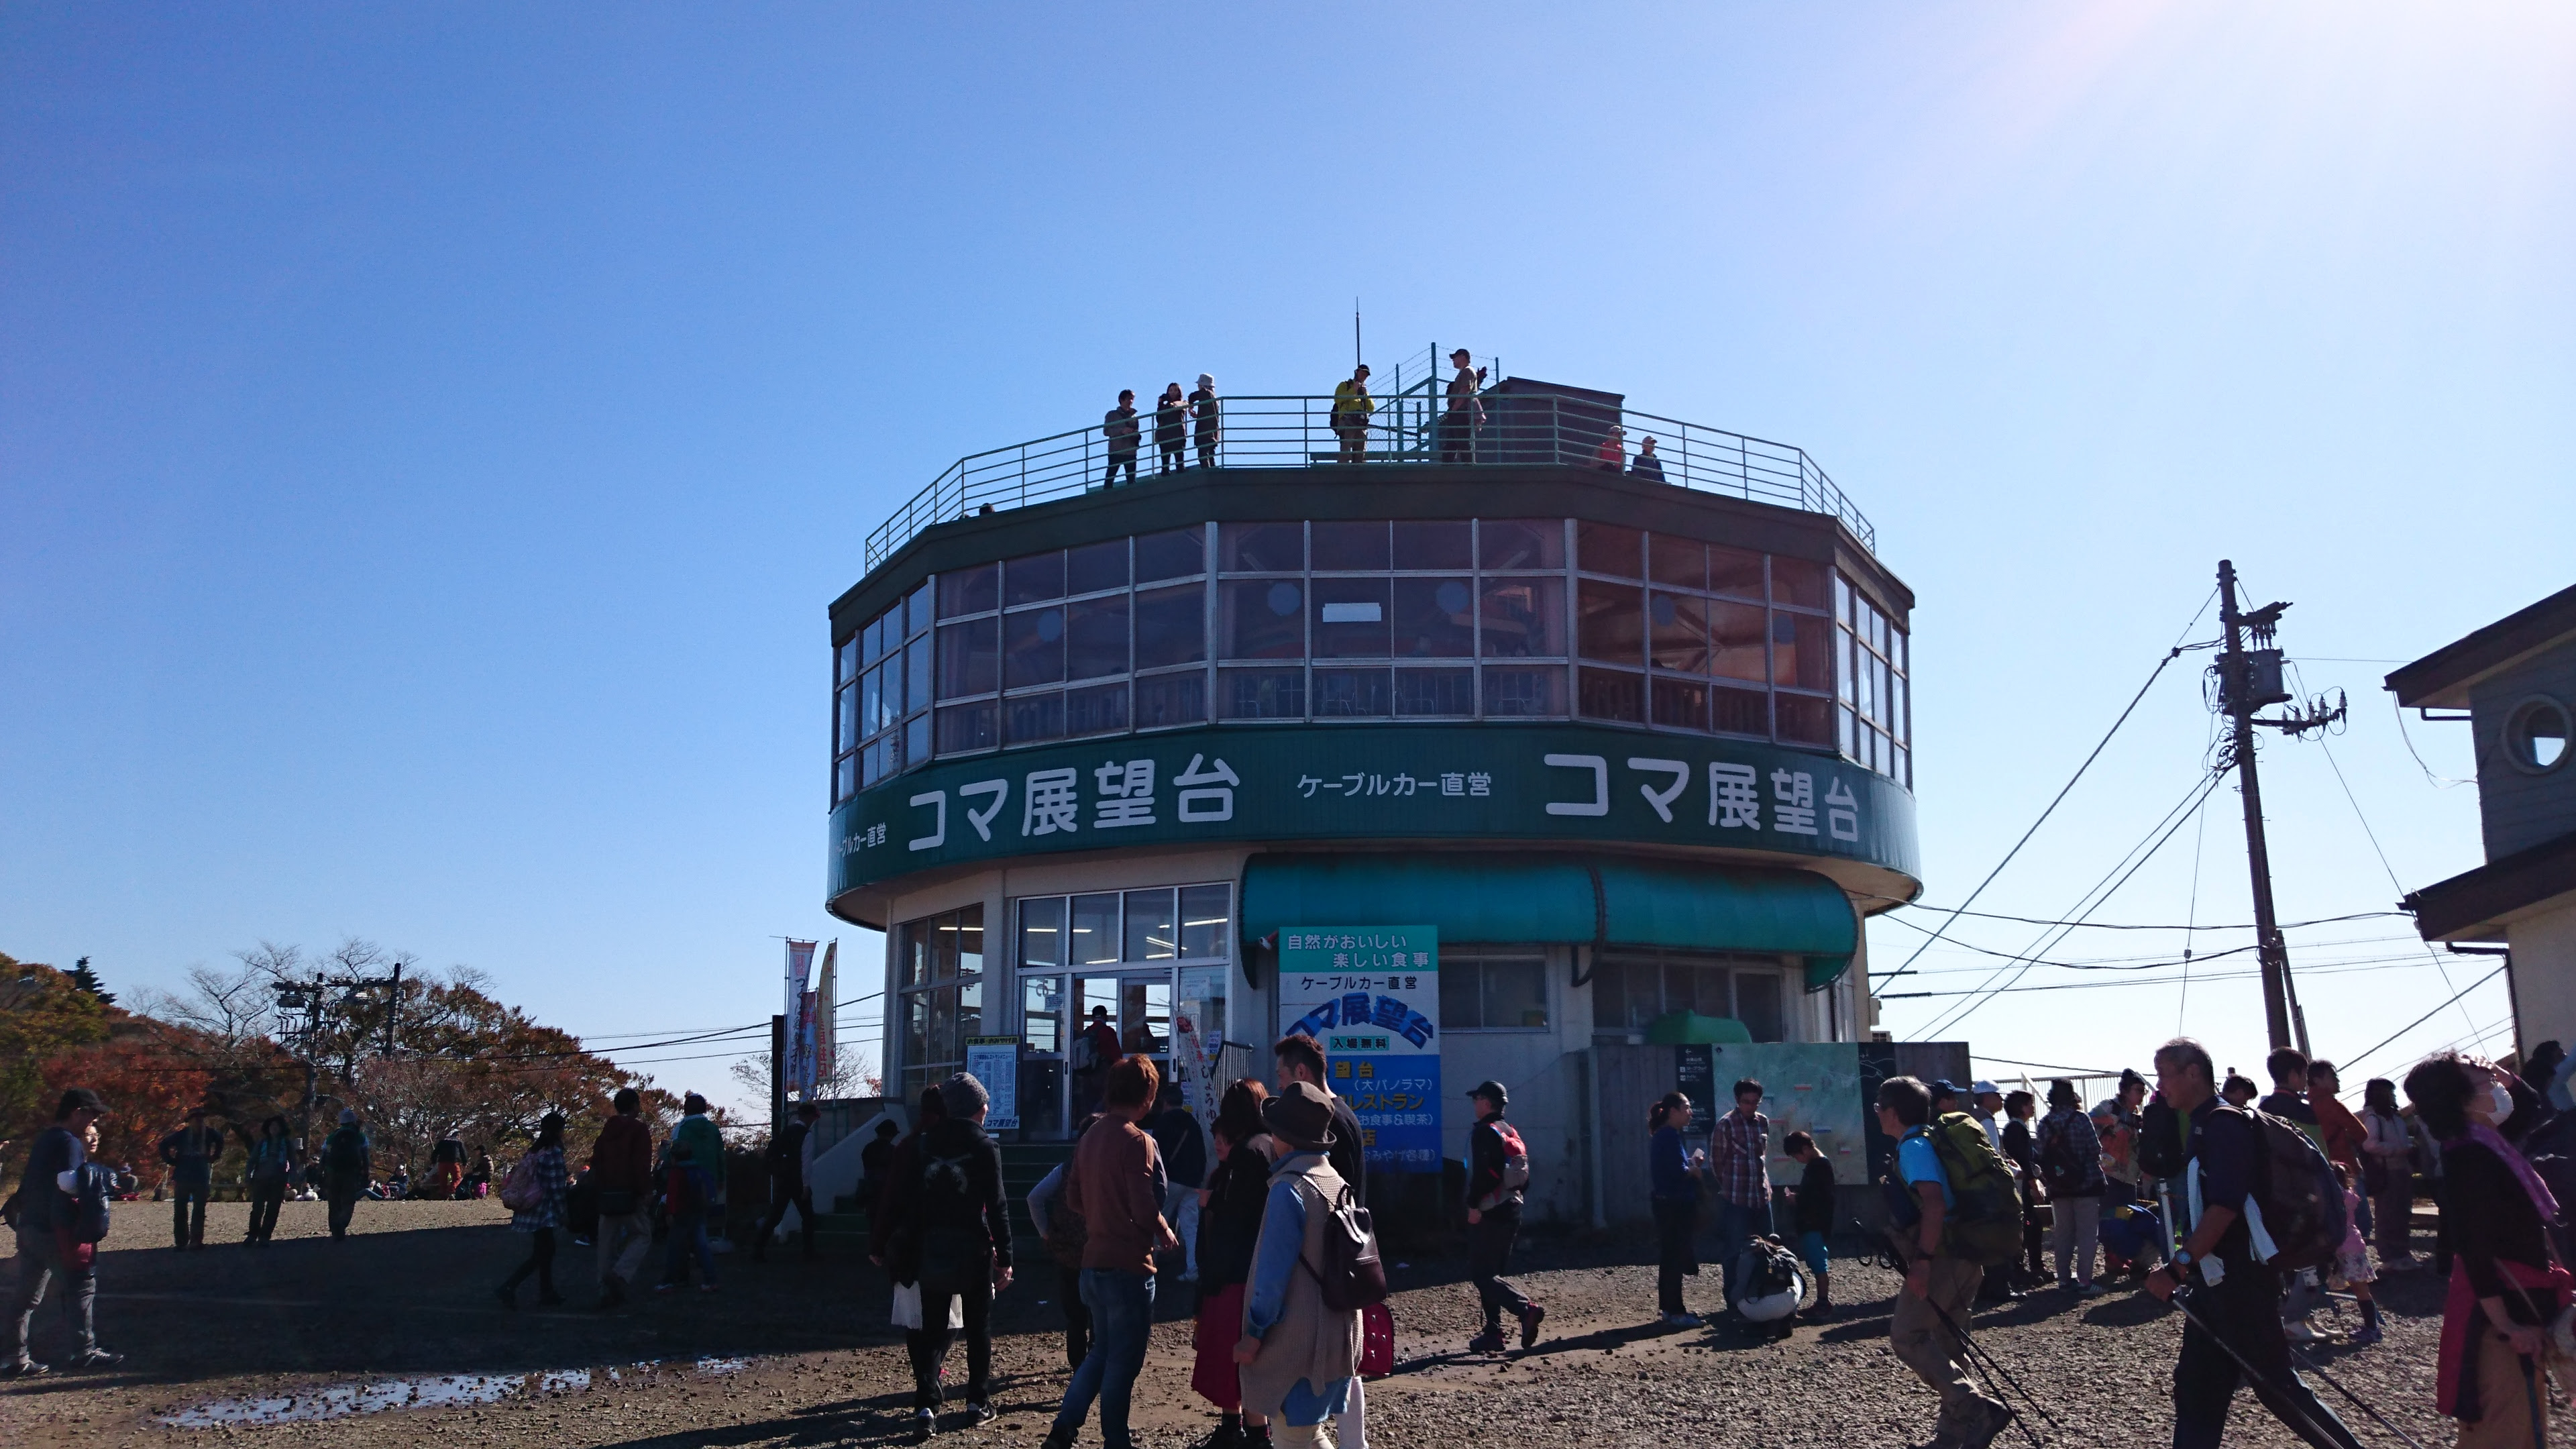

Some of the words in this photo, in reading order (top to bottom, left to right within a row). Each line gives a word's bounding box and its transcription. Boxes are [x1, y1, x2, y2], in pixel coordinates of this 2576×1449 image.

[1297, 771, 1492, 798] ケーブルカー直営
[908, 753, 1240, 851] コマ展望台
[1544, 753, 1860, 843] コマ展望台
[836, 822, 886, 858] ーブルカー直営
[1288, 934, 1407, 950] 自然がおいしい
[1333, 952, 1430, 968] 楽しい食事
[1301, 975, 1418, 991] ケーブルカー直営
[1332, 1036, 1387, 1049] 入場無料
[983, 1119, 1018, 1128] コマ展望台
